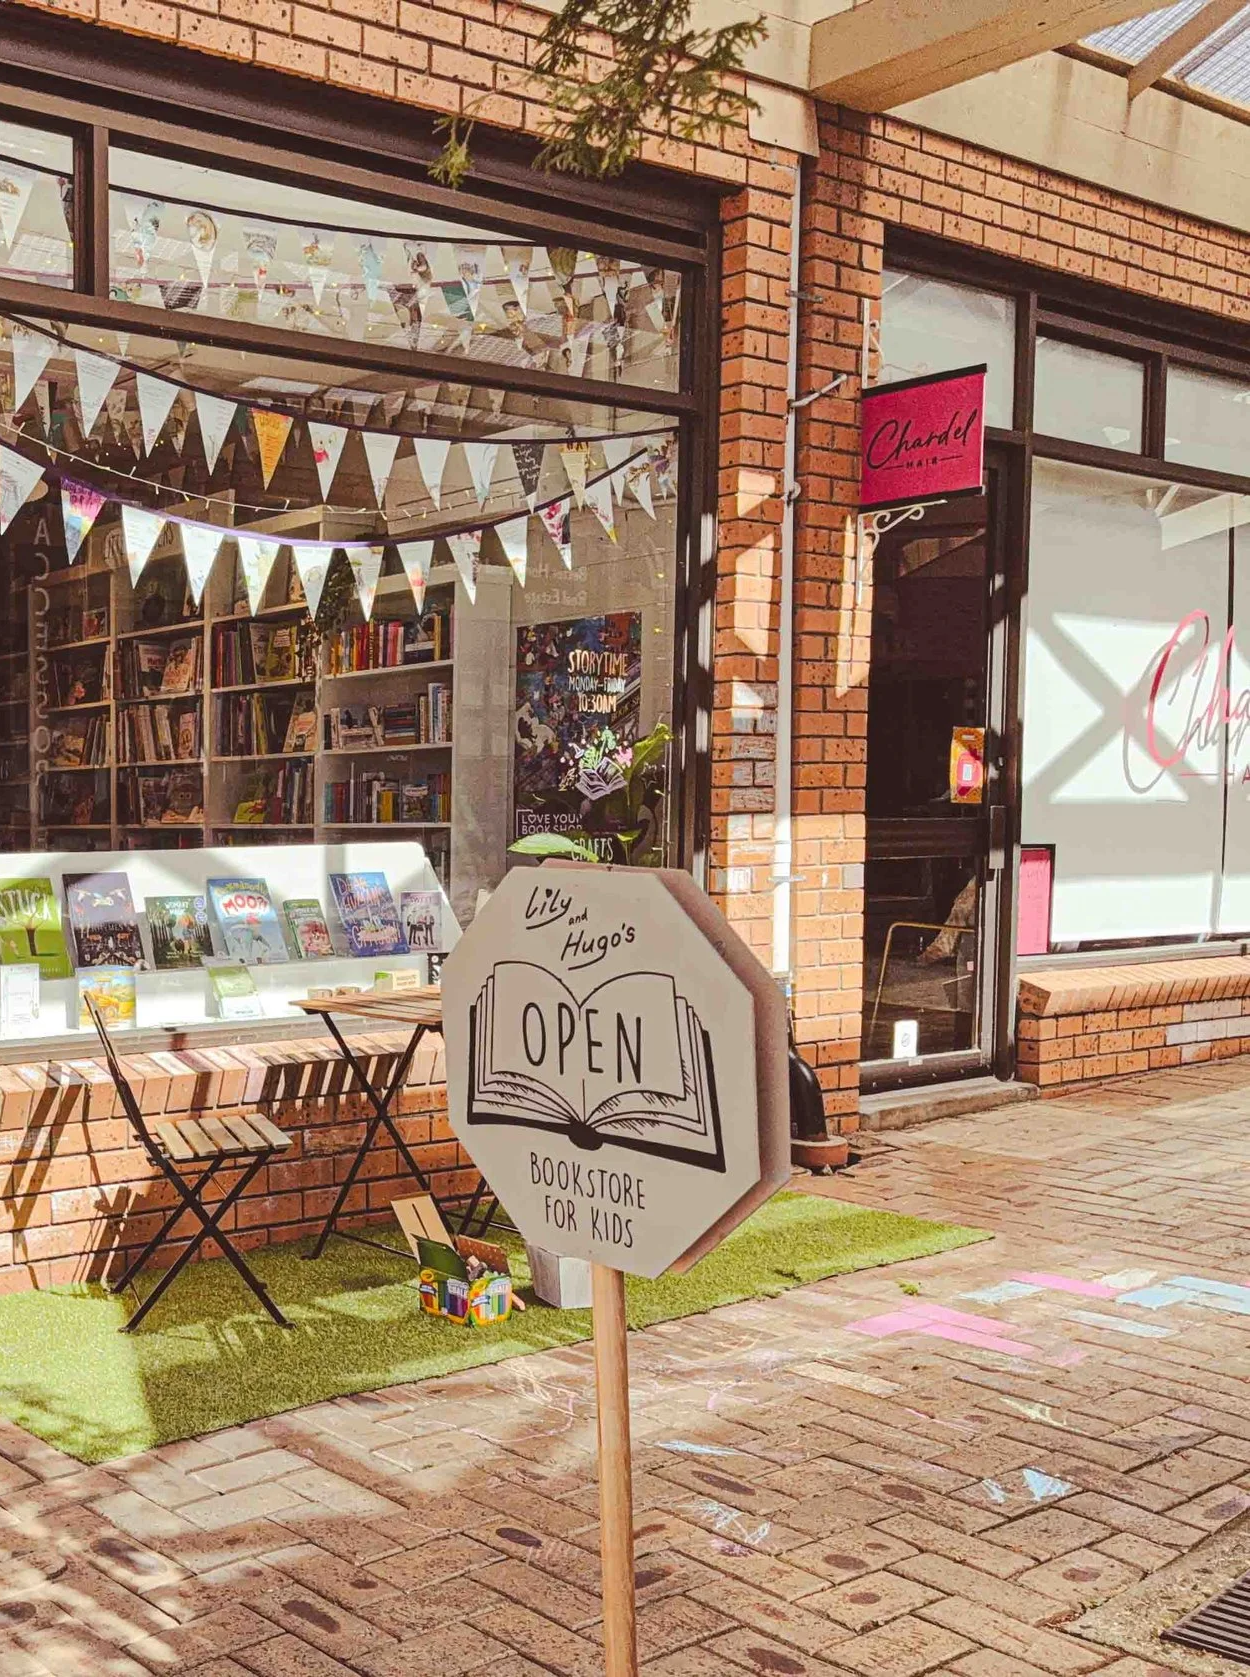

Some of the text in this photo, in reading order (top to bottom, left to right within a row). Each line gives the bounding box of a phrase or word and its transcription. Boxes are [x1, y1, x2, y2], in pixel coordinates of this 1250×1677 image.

[866, 408, 978, 470] Chardel
[906, 456, 938, 469] HAIR
[568, 649, 629, 677] STORYTIME
[525, 886, 572, 930] Lily
[568, 908, 588, 926] and
[560, 923, 635, 971] Hugo's
[522, 1001, 642, 1084] OPEN
[530, 1151, 646, 1210] BOOKSTORE
[545, 1195, 634, 1249] FOR KIDS
